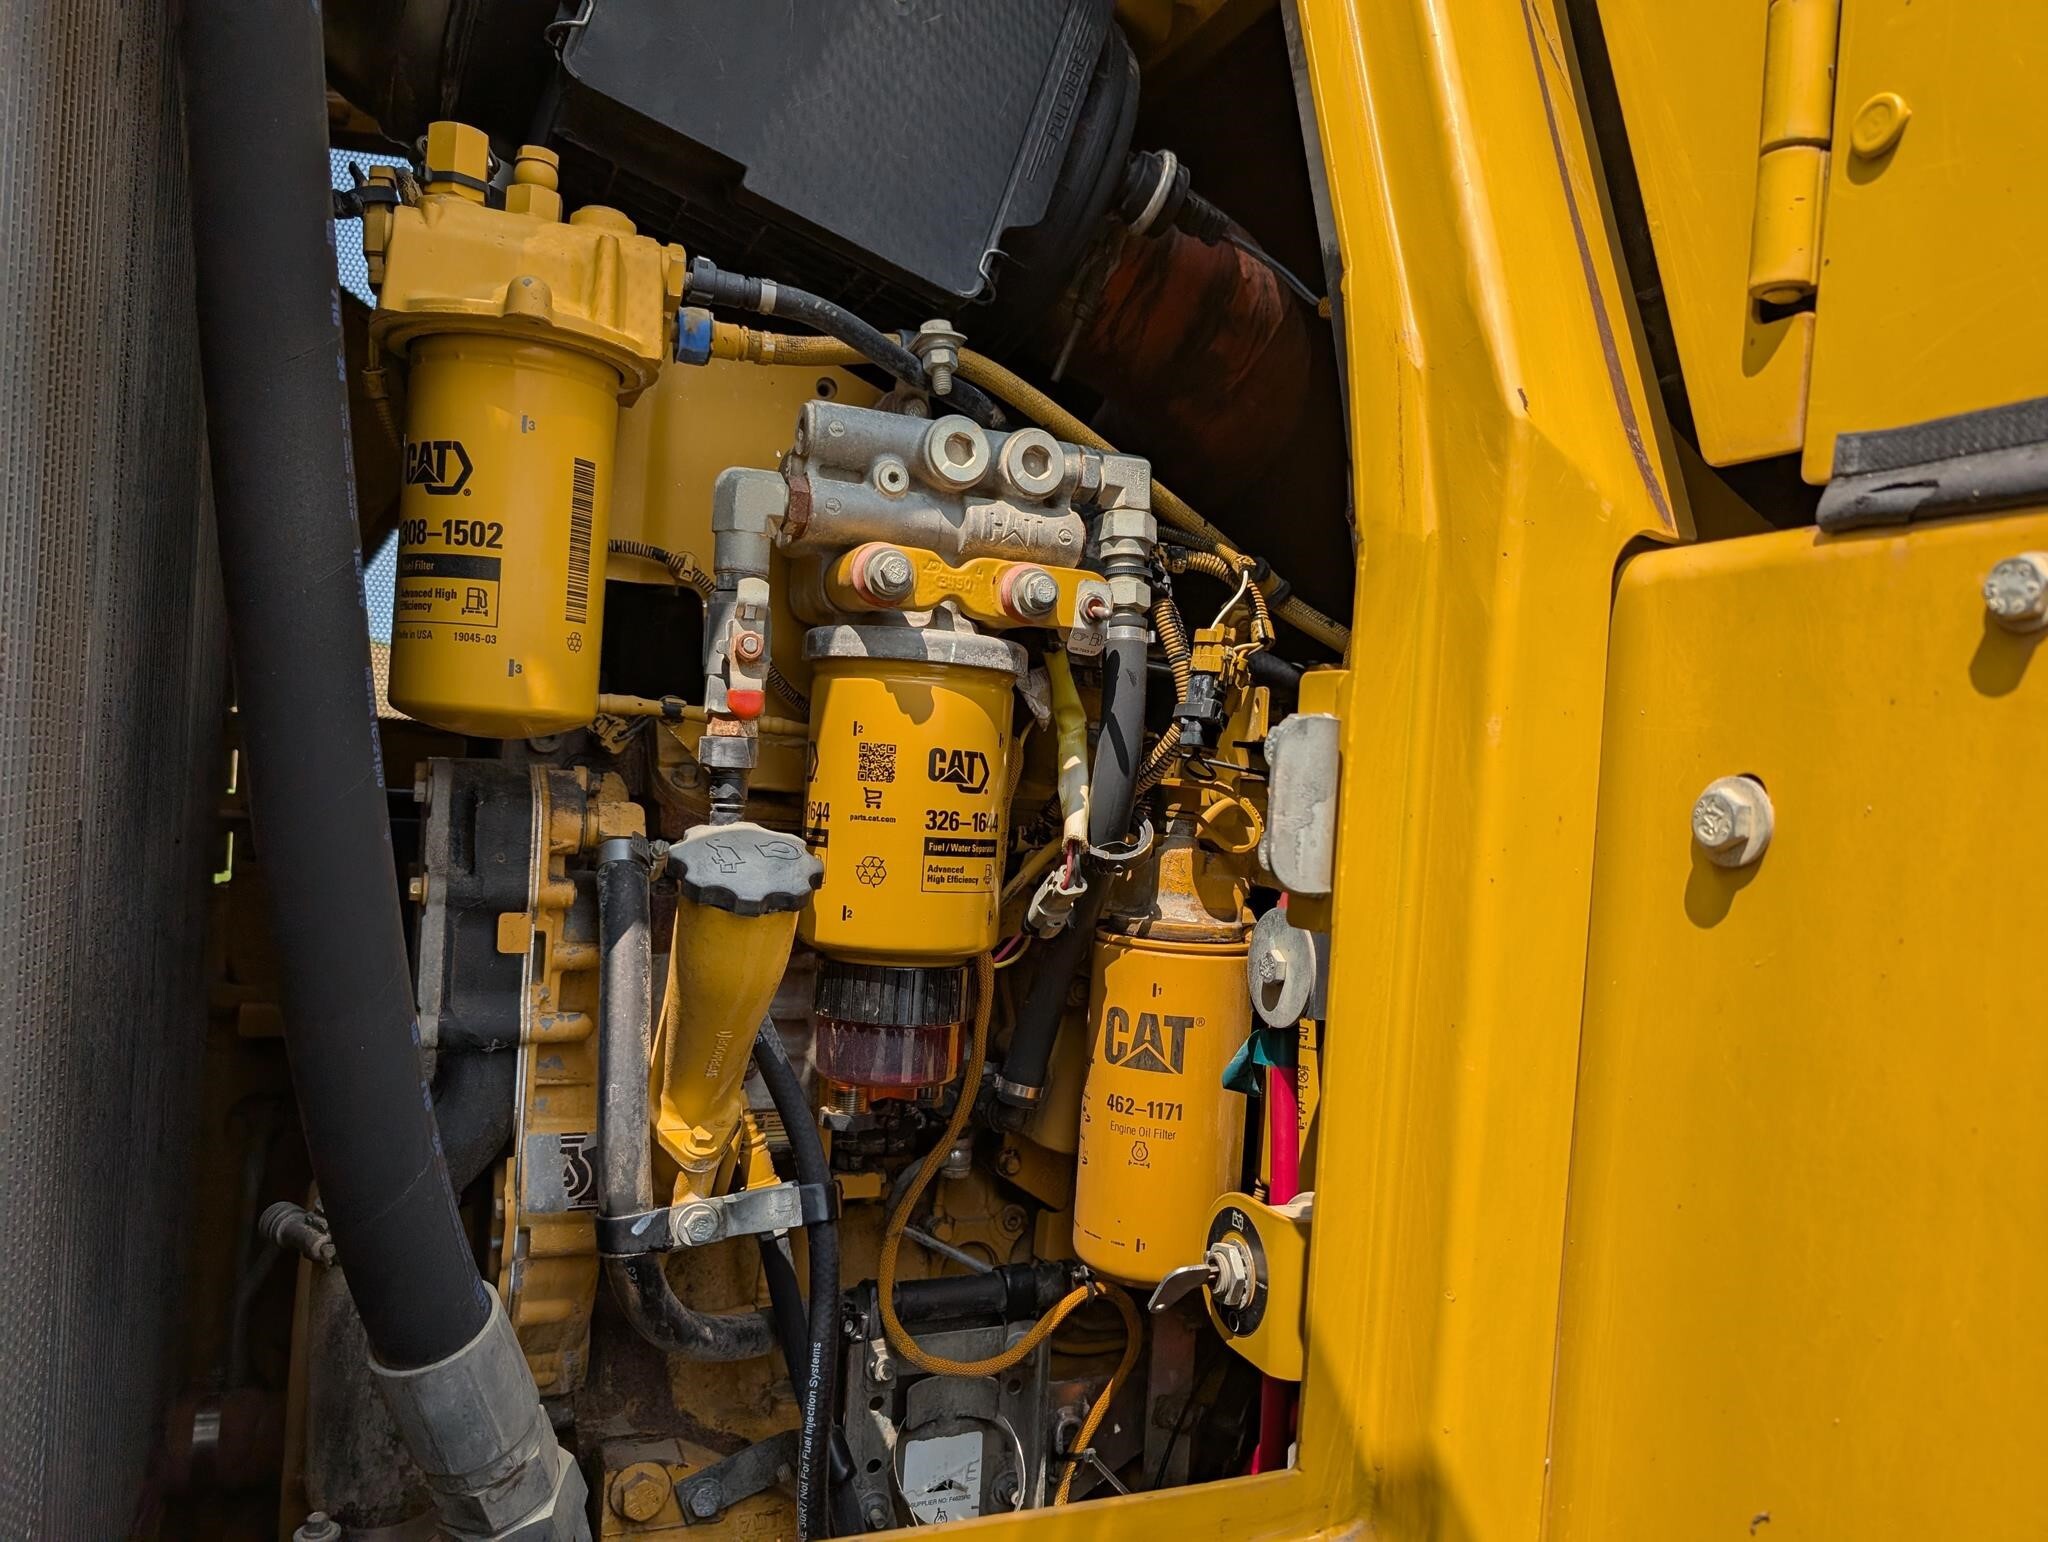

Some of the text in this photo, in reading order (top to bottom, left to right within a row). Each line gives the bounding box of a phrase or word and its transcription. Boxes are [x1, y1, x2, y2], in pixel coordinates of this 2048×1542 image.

[528, 420, 536, 431] 3
[406, 440, 453, 485] CAT
[401, 518, 504, 550] 308-1502
[414, 559, 435, 571] Filter
[434, 587, 458, 602] High
[416, 629, 433, 640] USA
[454, 631, 497, 645] 19045-03
[514, 663, 522, 674] 3
[857, 724, 864, 734] 2
[927, 747, 980, 785] CAT
[849, 814, 897, 824] parts.cat.com
[928, 842, 945, 852] Fuel
[950, 843, 971, 853] Water
[927, 864, 965, 874] Advanced
[926, 874, 980, 886] High Efficiency
[846, 909, 853, 919] 2
[1103, 1006, 1195, 1076] CAT
[1106, 1093, 1183, 1121] 462-1171
[1110, 1120, 1177, 1140] Engine Oil Filter
[809, 1342, 822, 1388] Systems
[804, 1390, 817, 1435] Injection
[802, 1434, 812, 1460] Fuel
[800, 1461, 810, 1480] For
[800, 1481, 809, 1500] Not
